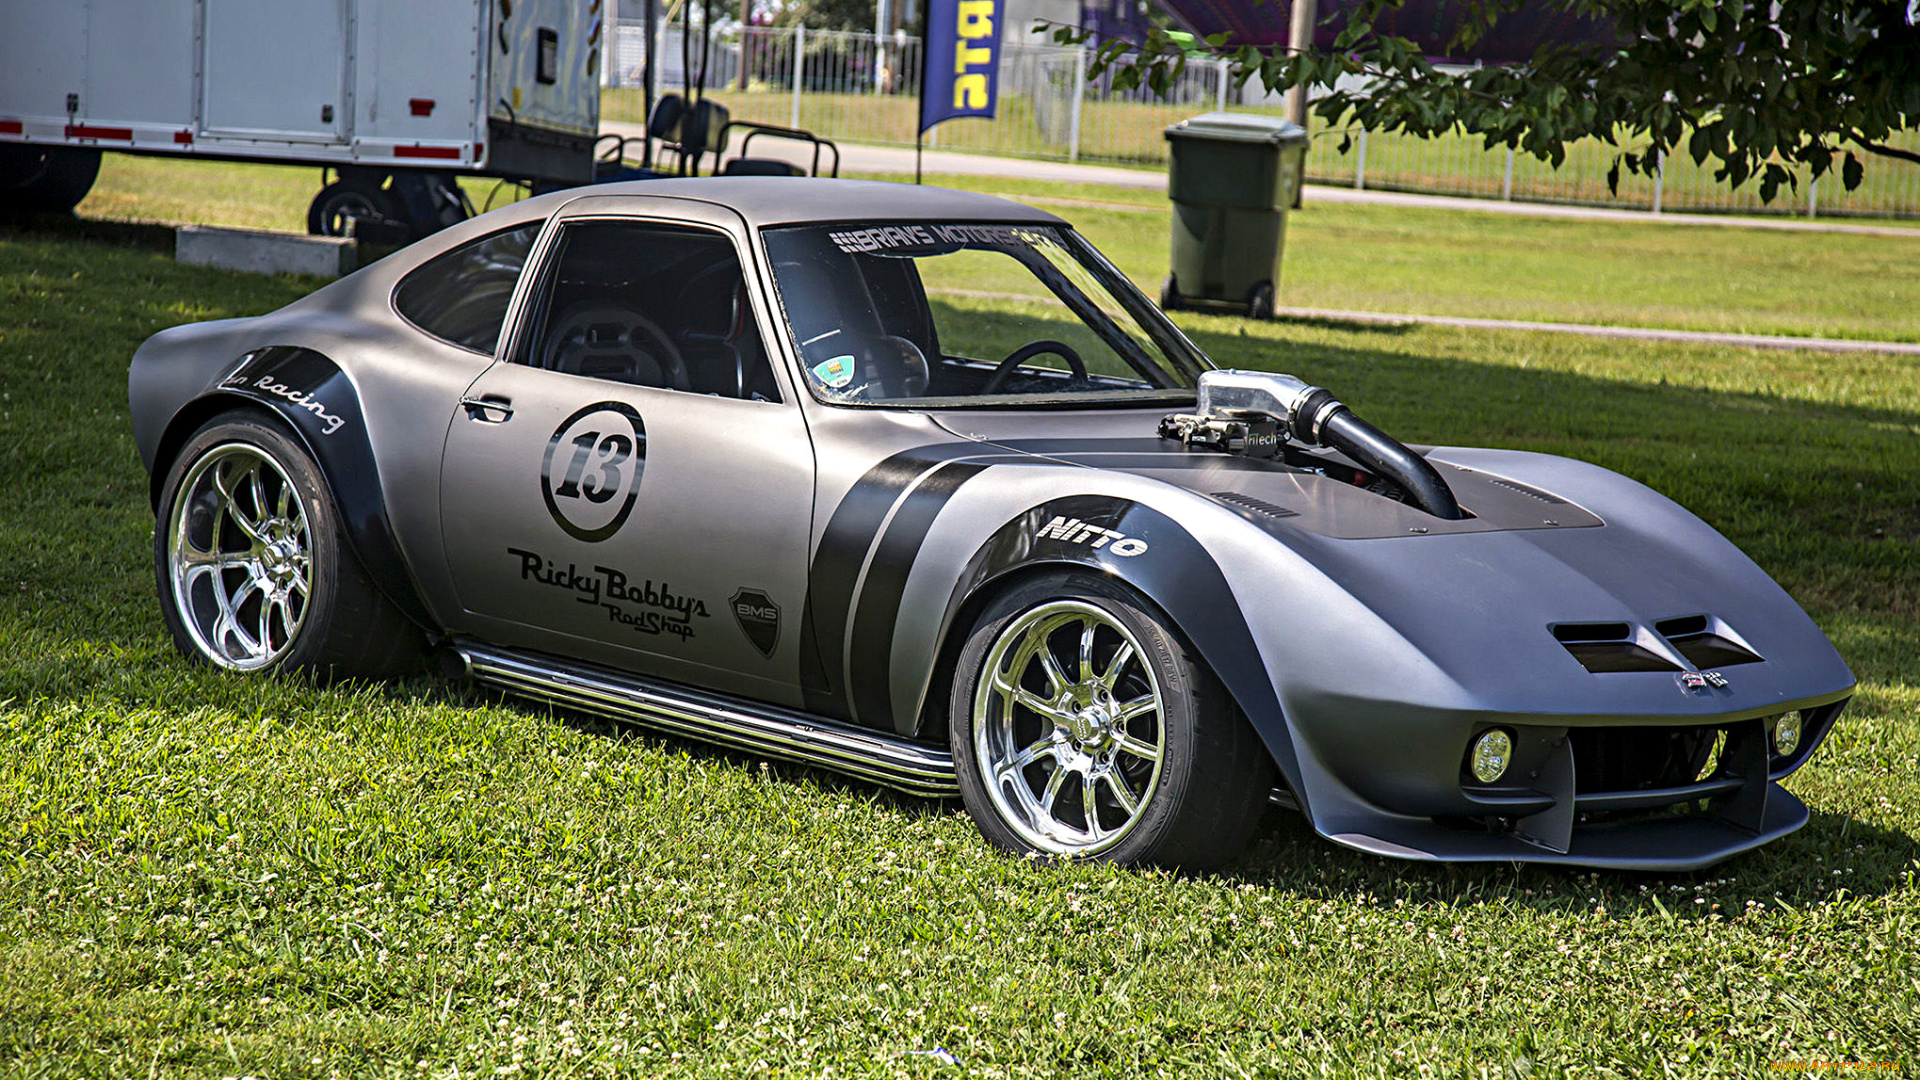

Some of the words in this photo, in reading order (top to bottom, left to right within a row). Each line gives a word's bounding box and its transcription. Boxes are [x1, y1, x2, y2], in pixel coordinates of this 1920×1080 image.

[856, 225, 936, 251] BRIAN'S
[253, 375, 346, 435] Racing
[556, 430, 633, 504] 13
[1035, 515, 1149, 557] NITTO
[736, 603, 778, 620] BMS
